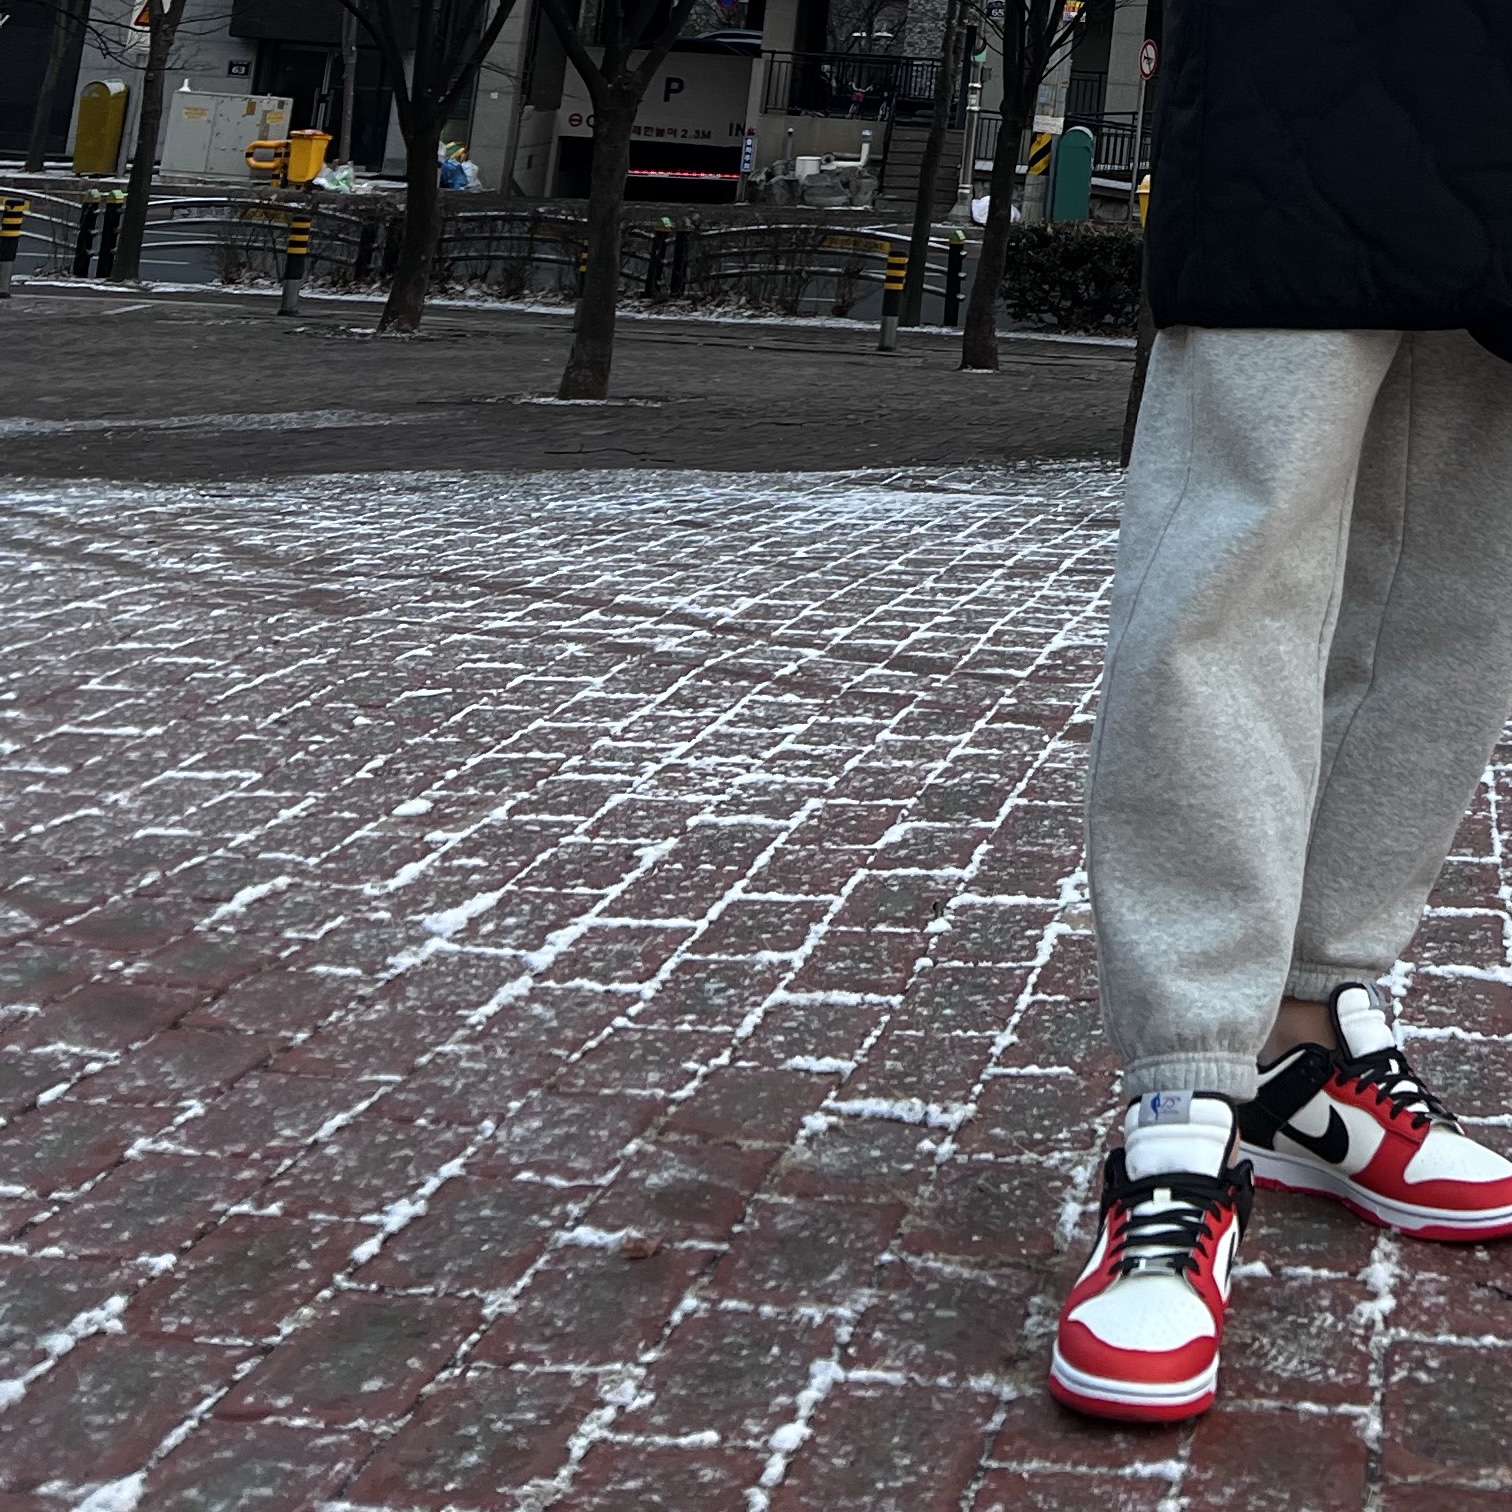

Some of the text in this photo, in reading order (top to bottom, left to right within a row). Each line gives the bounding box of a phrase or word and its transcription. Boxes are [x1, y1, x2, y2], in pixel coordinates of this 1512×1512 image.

[663, 76, 684, 102] P
[681, 129, 712, 139] 2.3M
[728, 123, 746, 137] IN
